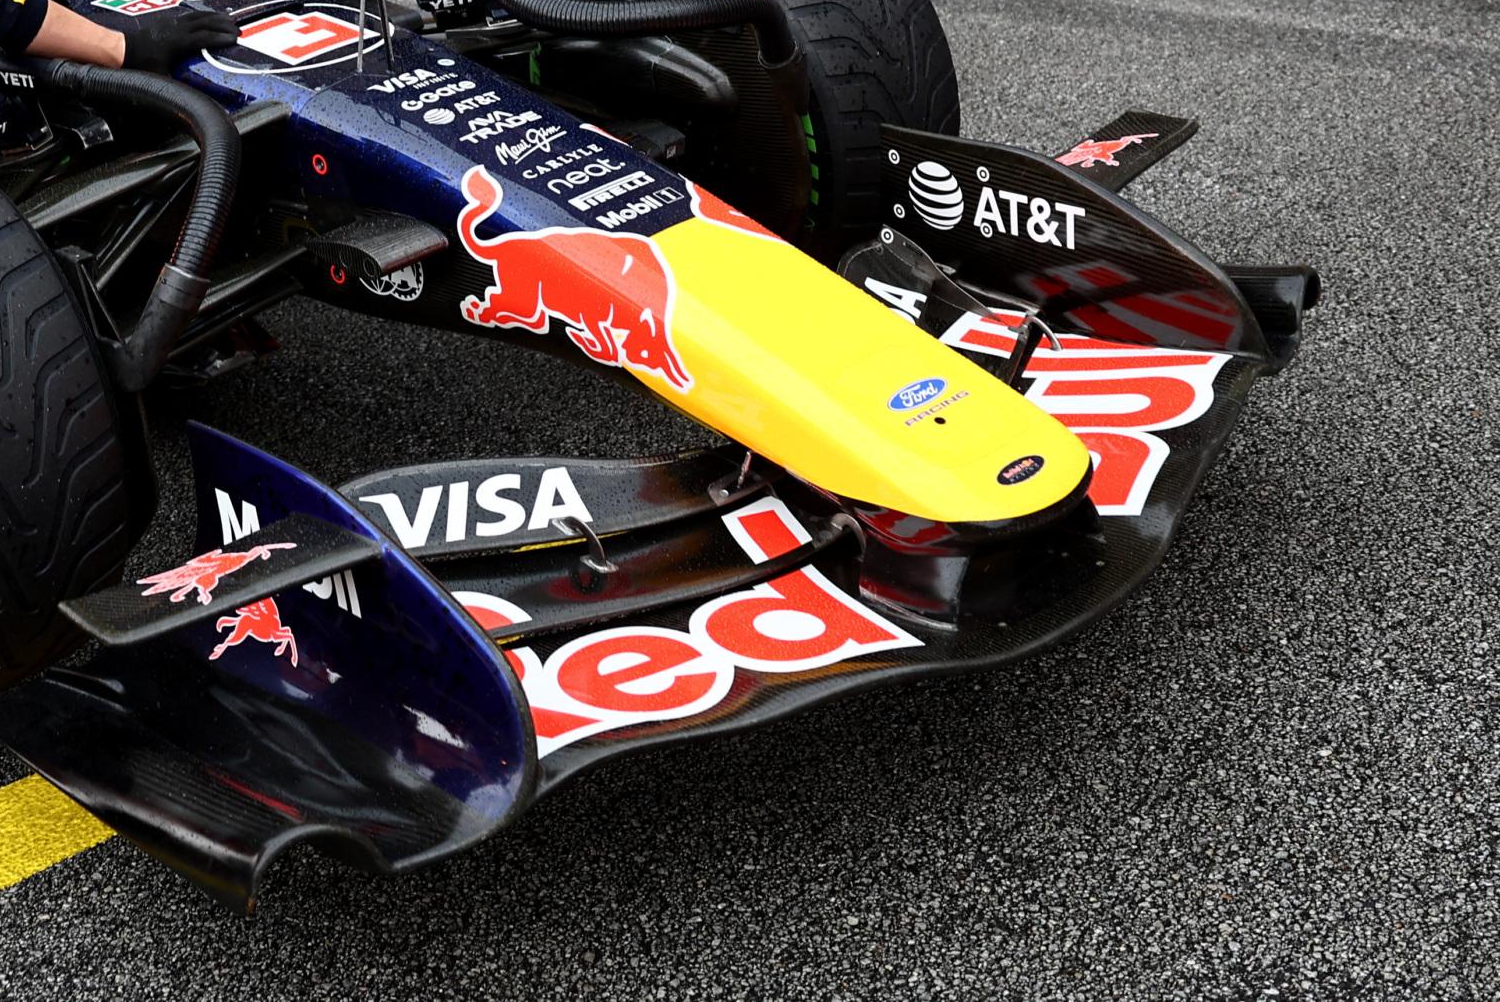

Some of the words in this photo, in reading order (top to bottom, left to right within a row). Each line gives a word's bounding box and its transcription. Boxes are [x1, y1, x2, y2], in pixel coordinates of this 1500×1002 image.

[0, 71, 34, 89] YETI
[367, 68, 437, 94] VISA
[412, 72, 459, 91] INFINITE
[419, 81, 477, 103] Gate
[454, 91, 501, 115] AT&T
[467, 110, 515, 131] AVA
[460, 110, 542, 145] TRADE
[495, 136, 531, 166] Maui
[527, 125, 567, 152] Jim
[522, 143, 604, 180] CARLYLE
[547, 160, 626, 195] neat.
[568, 171, 655, 212] PIRELLI
[596, 195, 661, 230] Mobil
[973, 186, 1087, 251] AT&T
[899, 381, 940, 406] Ford
[904, 390, 969, 427] RACING
[358, 466, 593, 549] VISA
